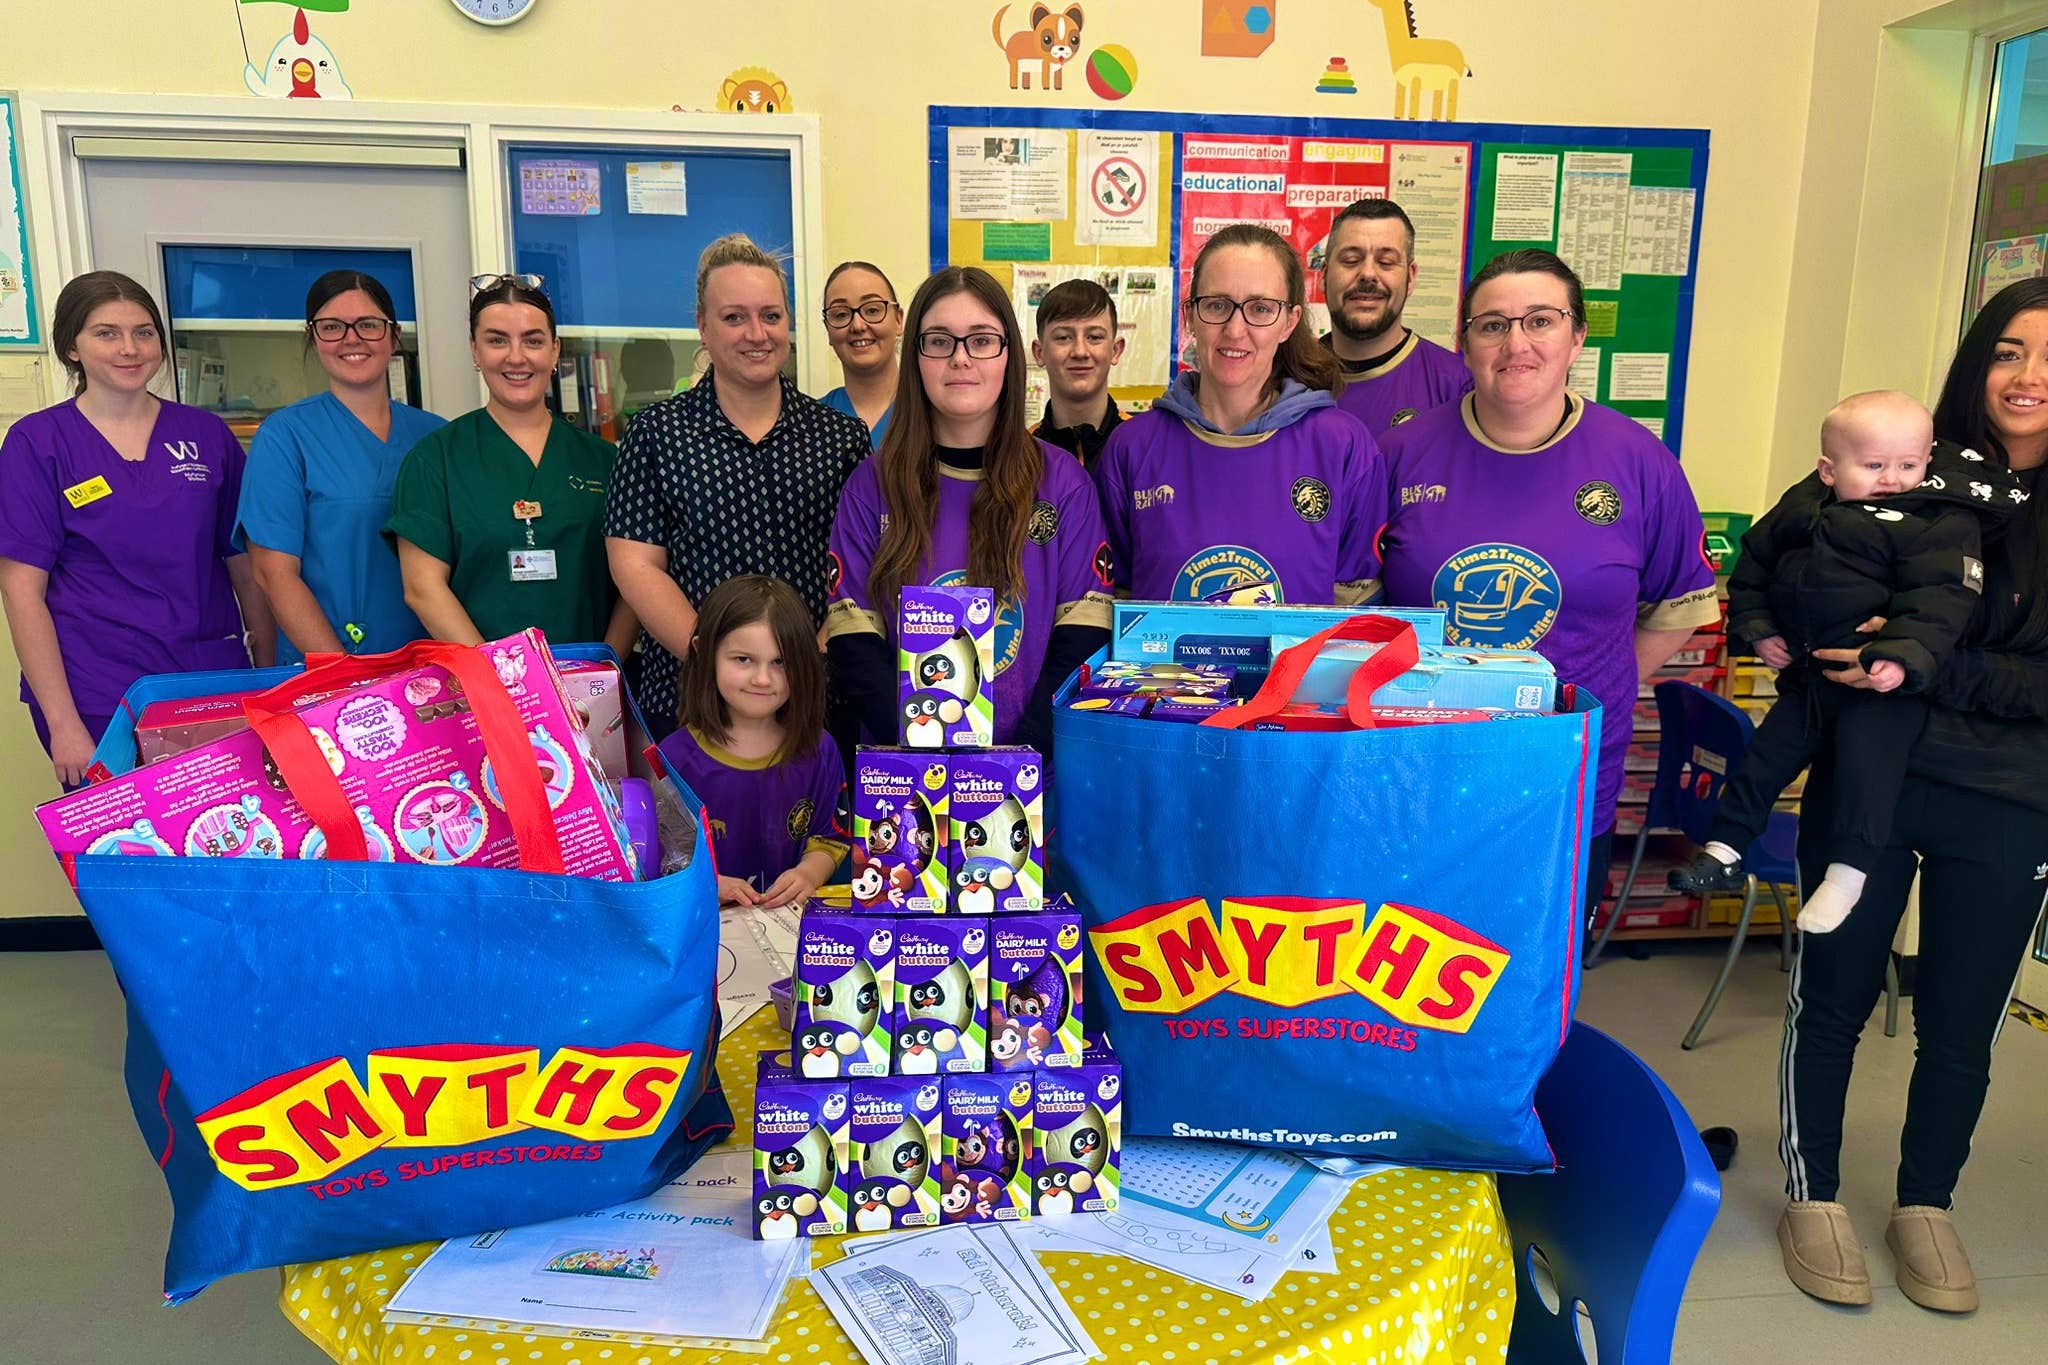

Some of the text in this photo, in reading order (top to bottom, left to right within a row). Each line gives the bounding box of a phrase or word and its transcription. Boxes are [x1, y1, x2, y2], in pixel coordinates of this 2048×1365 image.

[492, 3, 500, 13] 6
[1188, 145, 1287, 159] communication
[1305, 144, 1382, 161] engaging
[1184, 175, 1283, 192] educational
[1287, 188, 1384, 204] preparation
[1185, 550, 1271, 580] Time2Travel
[1448, 547, 1550, 578] Time2Travel
[904, 600, 934, 611] Cadbury
[904, 611, 955, 623] white
[904, 623, 955, 634] buttons
[1529, 609, 1555, 638] Hire
[1179, 645, 1212, 655] 300 XXL
[1218, 647, 1251, 656] 200 XXL
[590, 687, 605, 696] 8+
[342, 703, 389, 725] LECKERE
[535, 724, 549, 742] 1
[357, 733, 387, 750] TASTY
[860, 766, 890, 777] Cadbury
[953, 769, 984, 780] Cadbury
[449, 772, 470, 791] 2
[860, 776, 914, 785] DAIRY MILK
[954, 780, 1003, 791] white
[865, 786, 910, 796] buttons
[953, 792, 1004, 802] buttons
[242, 794, 260, 813] 4
[577, 805, 594, 818] Mini
[133, 819, 156, 839] 5
[805, 931, 835, 943] Cadbury
[900, 933, 929, 943] Cadbury
[995, 930, 1024, 940] Cadbury
[805, 942, 855, 955] white
[900, 943, 950, 955] white
[996, 938, 1048, 948] DAIRY MILK
[1000, 949, 1045, 958] buttons
[804, 954, 855, 966] buttons
[899, 954, 950, 966] buttons
[1104, 915, 1492, 1020] SMYTHS
[1164, 1017, 1419, 1052] TOYS SUPERSTORES
[1037, 1081, 1066, 1092] Cadbury
[853, 1092, 883, 1103] Cadbury
[948, 1088, 977, 1098] Cadbury
[1037, 1091, 1086, 1103] white
[758, 1100, 788, 1111] Cadbury
[948, 1095, 1000, 1105] DAIRY MILK
[853, 1102, 903, 1114] white
[952, 1105, 997, 1115] buttons
[1037, 1102, 1086, 1113] buttons
[214, 1062, 680, 1183] SMYTHS
[758, 1111, 810, 1123] white
[853, 1113, 904, 1125] buttons
[758, 1123, 810, 1134] buttons
[1171, 1121, 1399, 1147] SmythsToys.com
[306, 1143, 603, 1200] TOYS SUPERSTORES
[614, 1210, 735, 1226] Activity pack
[957, 1248, 1038, 1332] Eid Mubarak!
[520, 1296, 544, 1305] Name
